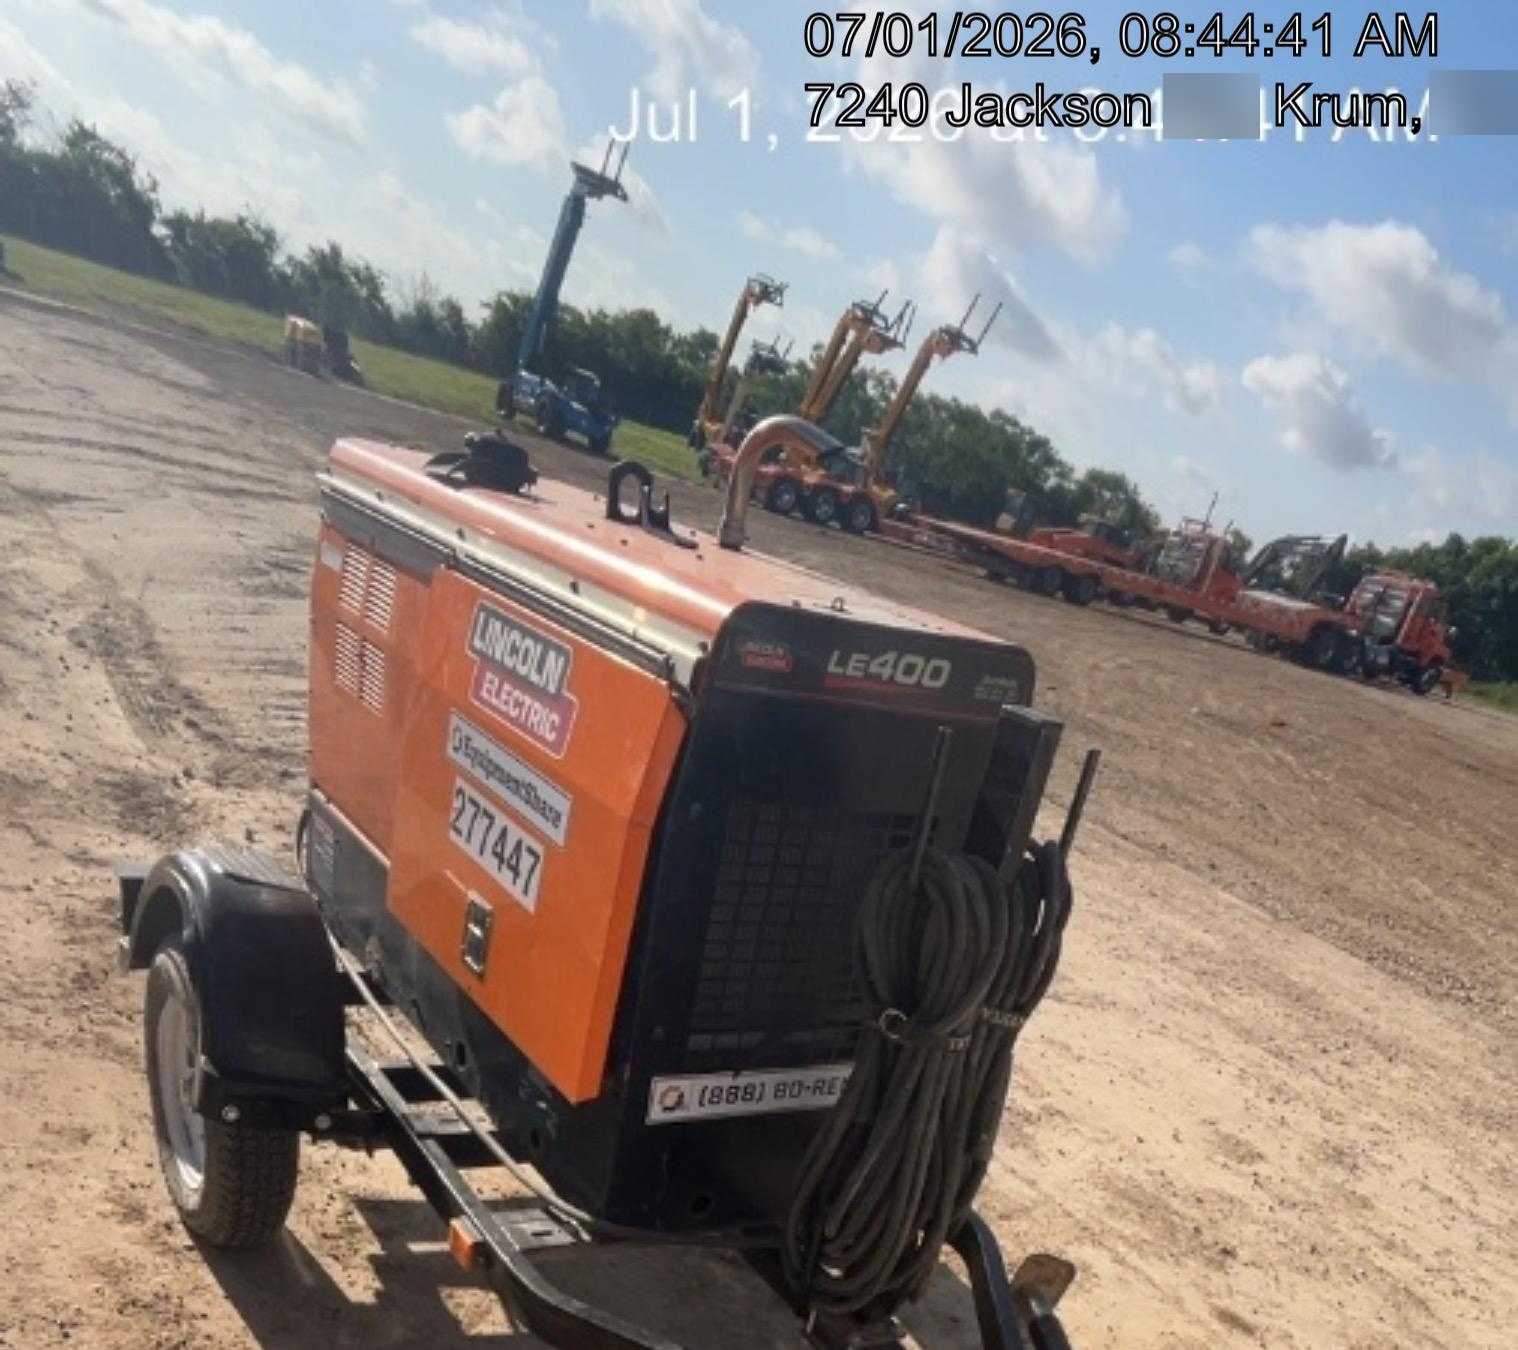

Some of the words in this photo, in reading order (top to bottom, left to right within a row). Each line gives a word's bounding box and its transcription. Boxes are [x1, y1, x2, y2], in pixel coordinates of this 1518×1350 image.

[473, 611, 565, 694] LINCOLN
[827, 650, 951, 689] LE400
[480, 671, 561, 742] ELECTRIC
[463, 734, 562, 829] EquipmentShare
[452, 786, 541, 897] 277447
[698, 1082, 766, 1108] (888)
